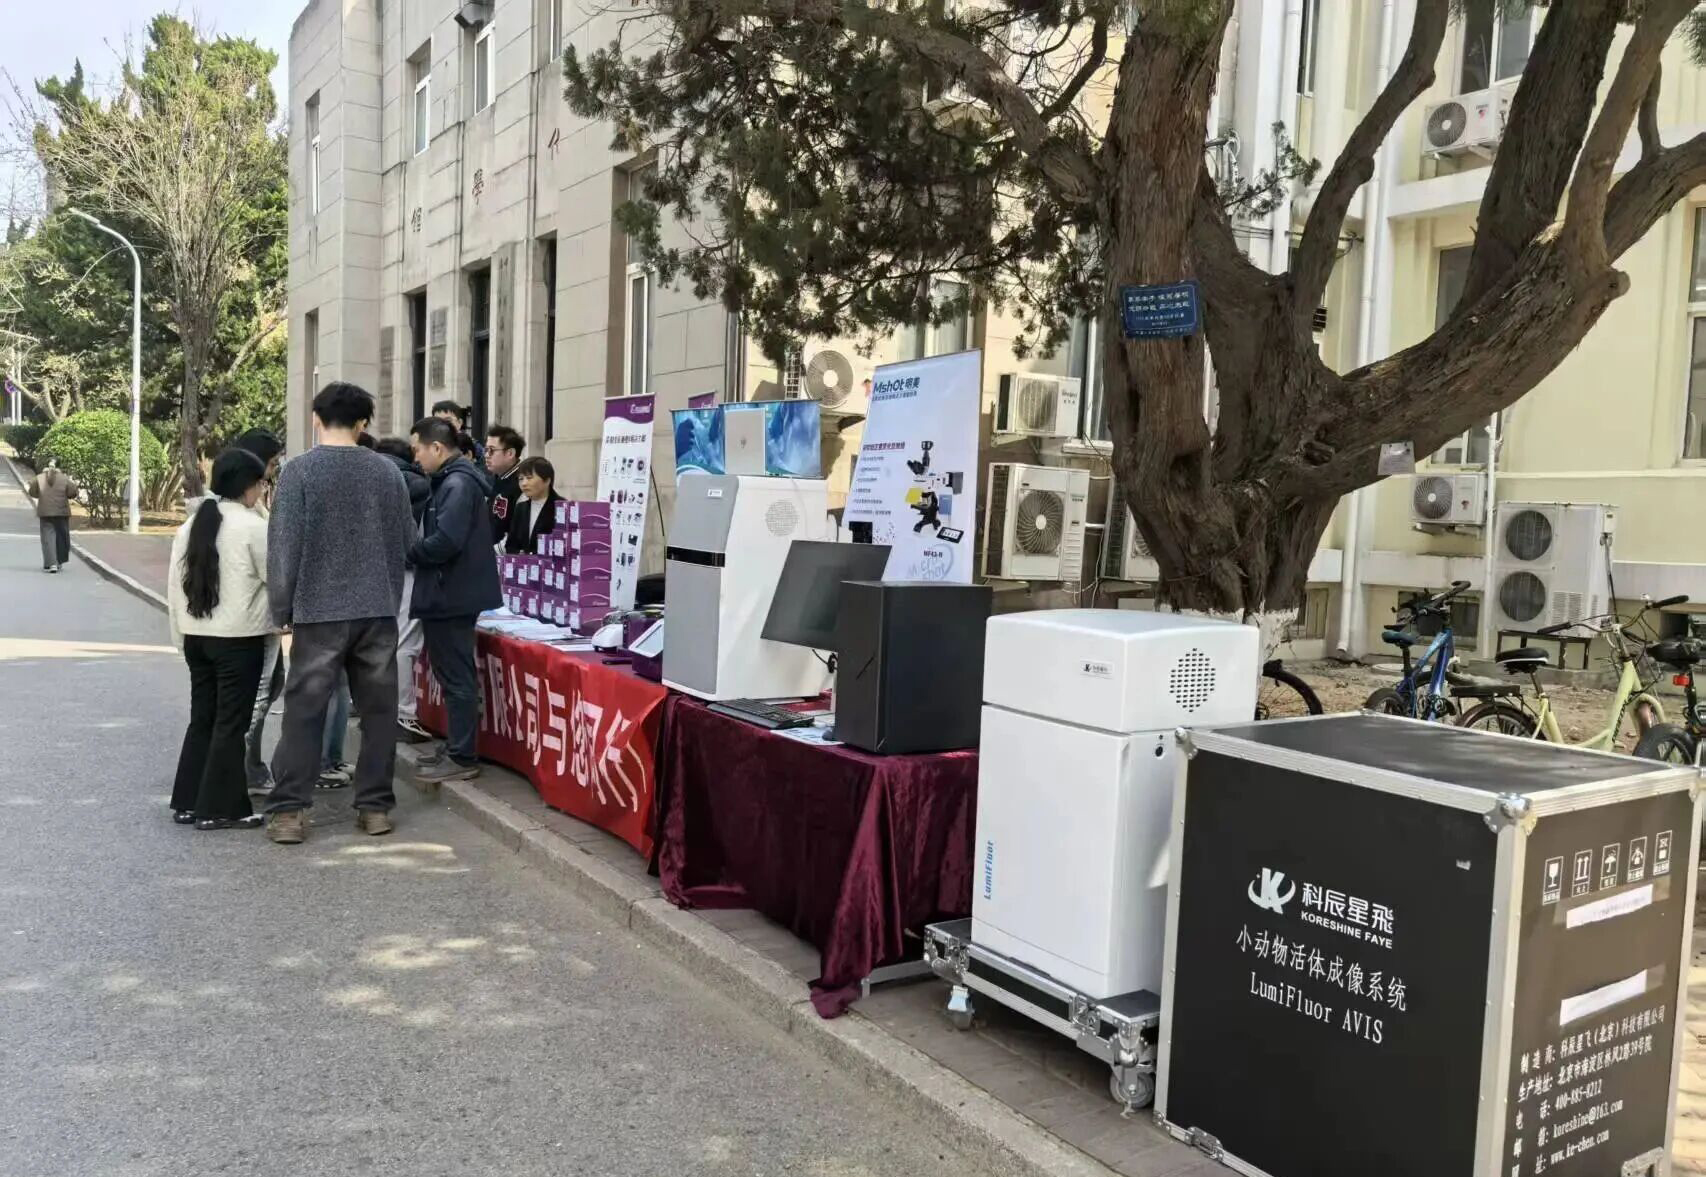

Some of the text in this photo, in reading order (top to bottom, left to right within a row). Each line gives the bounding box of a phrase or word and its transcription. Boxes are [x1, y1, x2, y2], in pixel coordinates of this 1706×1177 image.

[1300, 910, 1393, 950] KORESHINE FAYE
[1301, 881, 1395, 935] 科辰星飛
[1235, 923, 1407, 1012] 小动物活体成像系统
[1250, 971, 1384, 1044] LumiFluor AVIS
